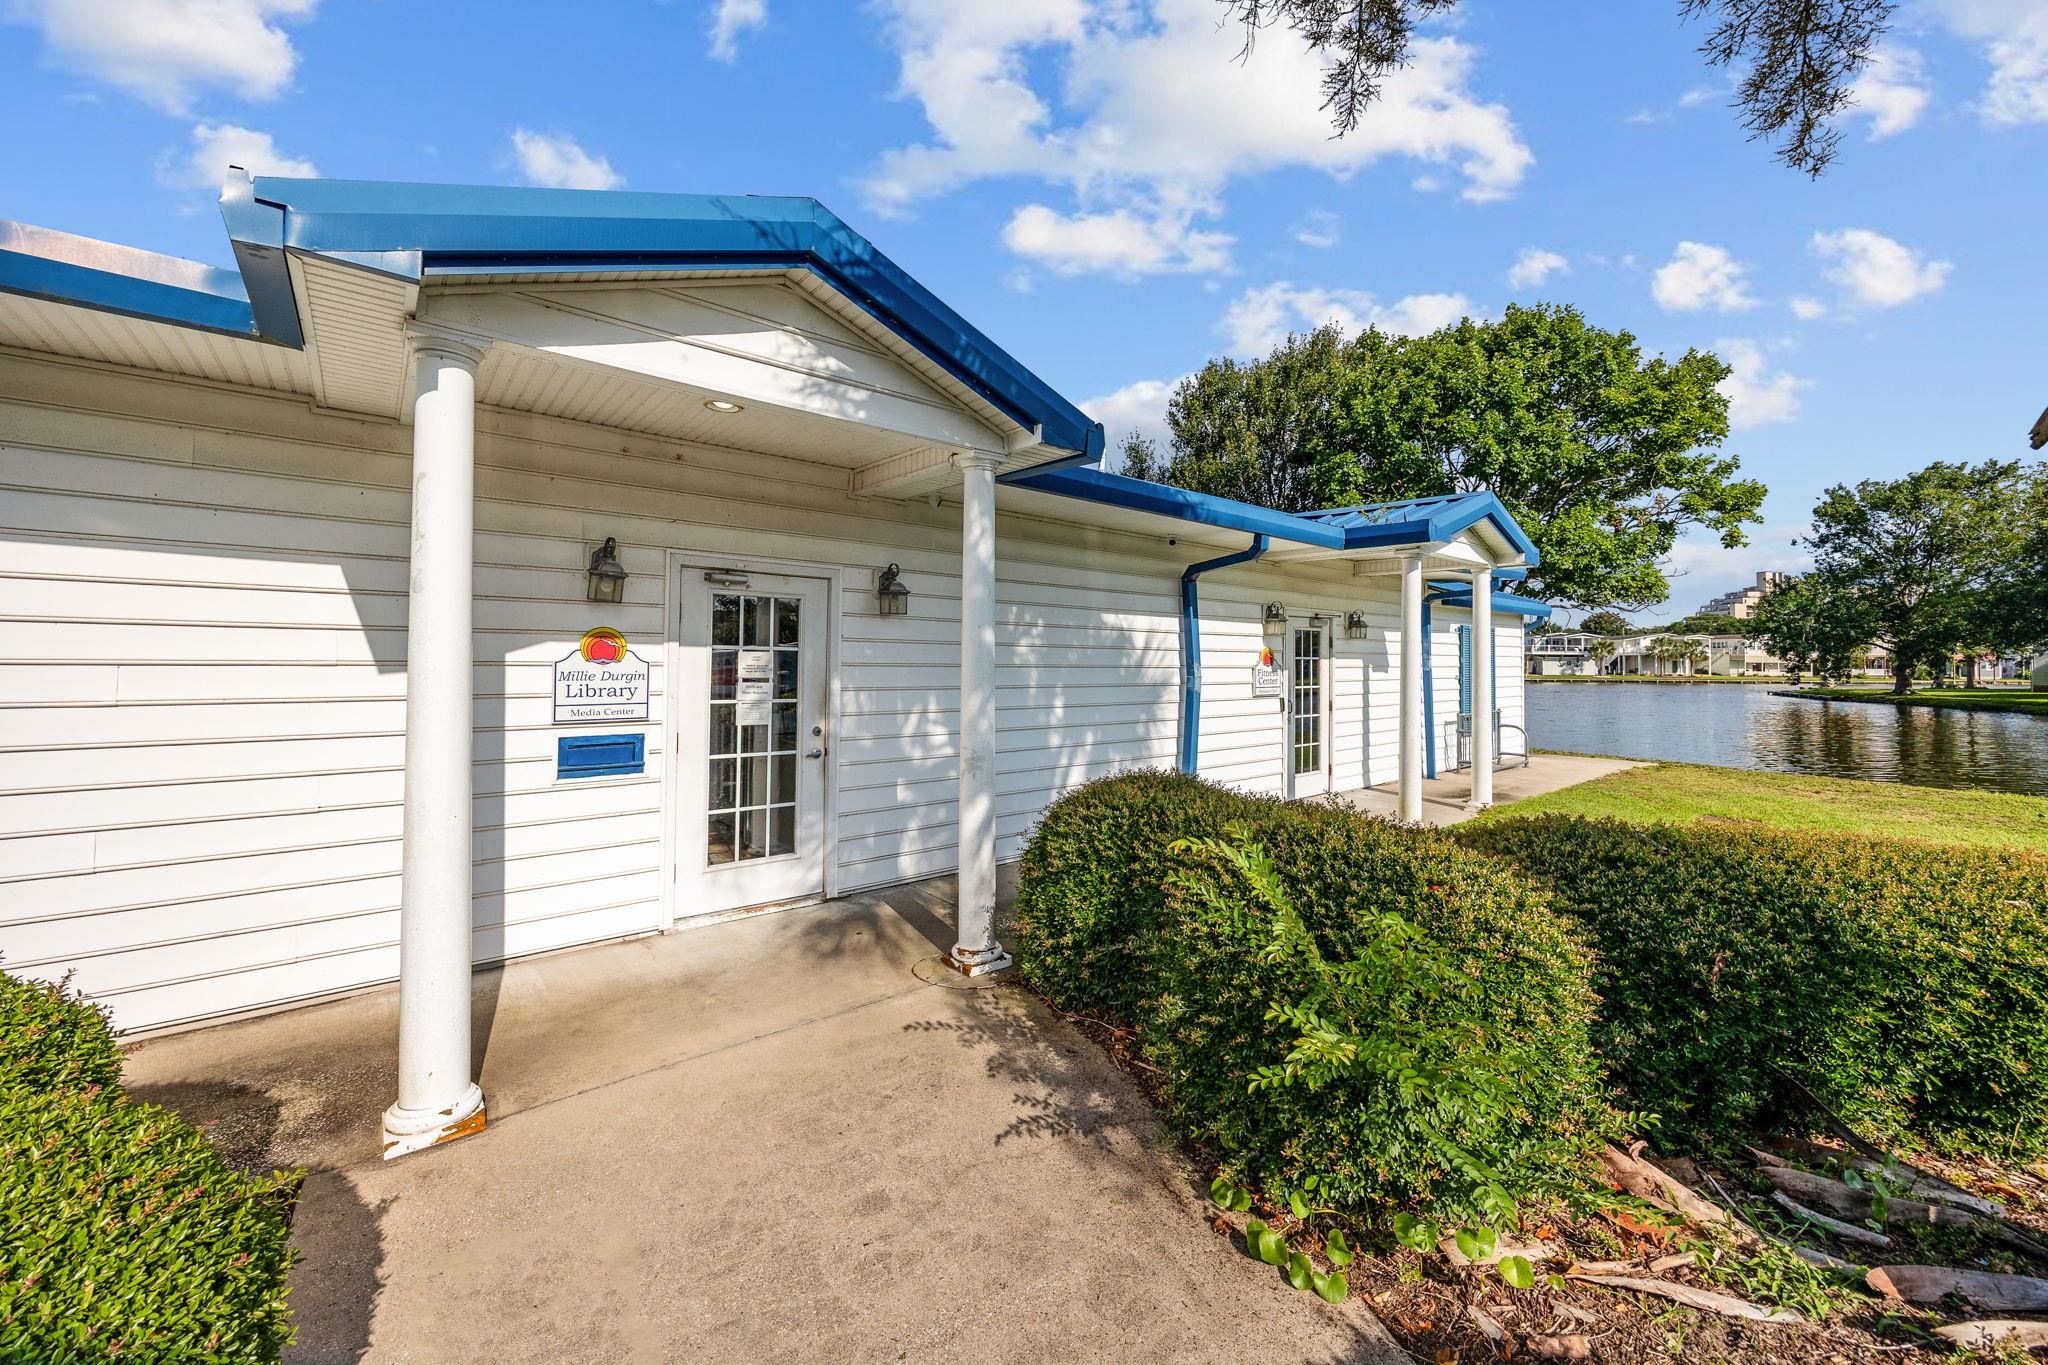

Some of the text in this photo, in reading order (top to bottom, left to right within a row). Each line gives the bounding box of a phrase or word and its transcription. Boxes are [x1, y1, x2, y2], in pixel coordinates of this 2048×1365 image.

[558, 670, 646, 684] Millie Durgin
[1258, 677, 1278, 685] Center
[565, 684, 638, 700] Library
